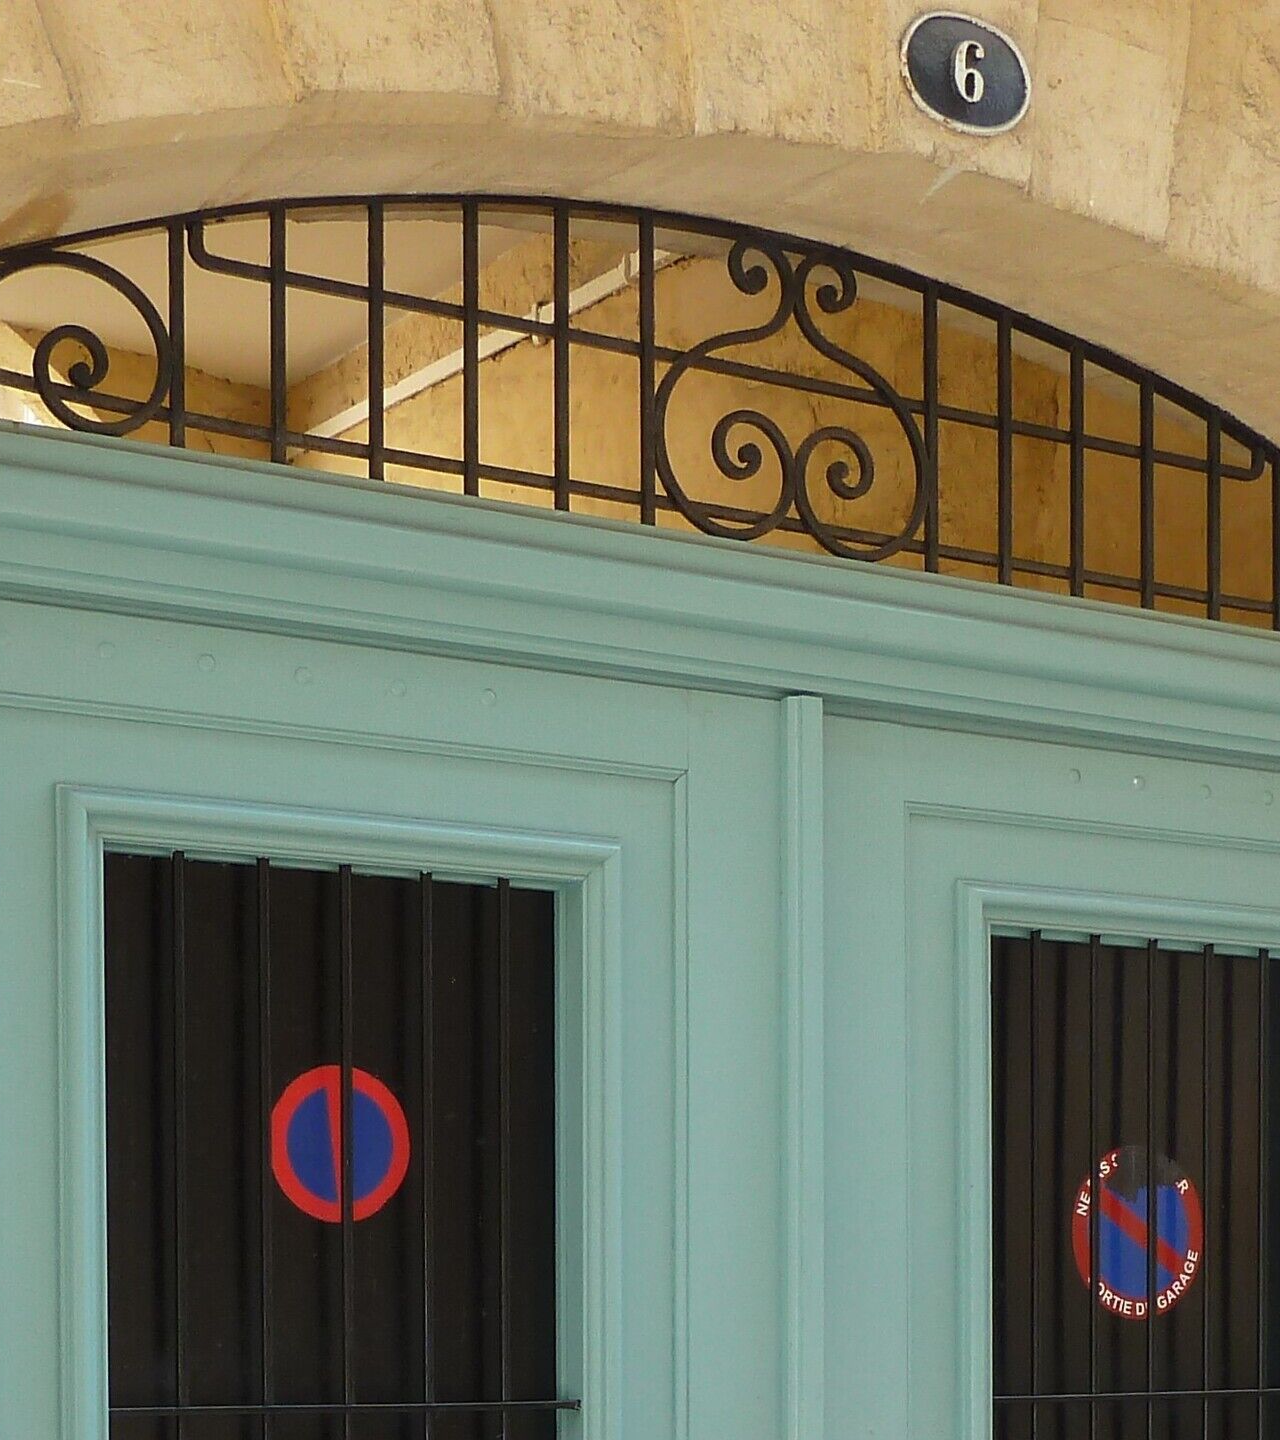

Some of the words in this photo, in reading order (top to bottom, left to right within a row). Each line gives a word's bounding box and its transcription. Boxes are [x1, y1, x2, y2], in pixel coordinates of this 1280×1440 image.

[954, 40, 985, 103] 6
[1076, 1190, 1091, 1217] NE
[1156, 1249, 1199, 1309] GARAGE
